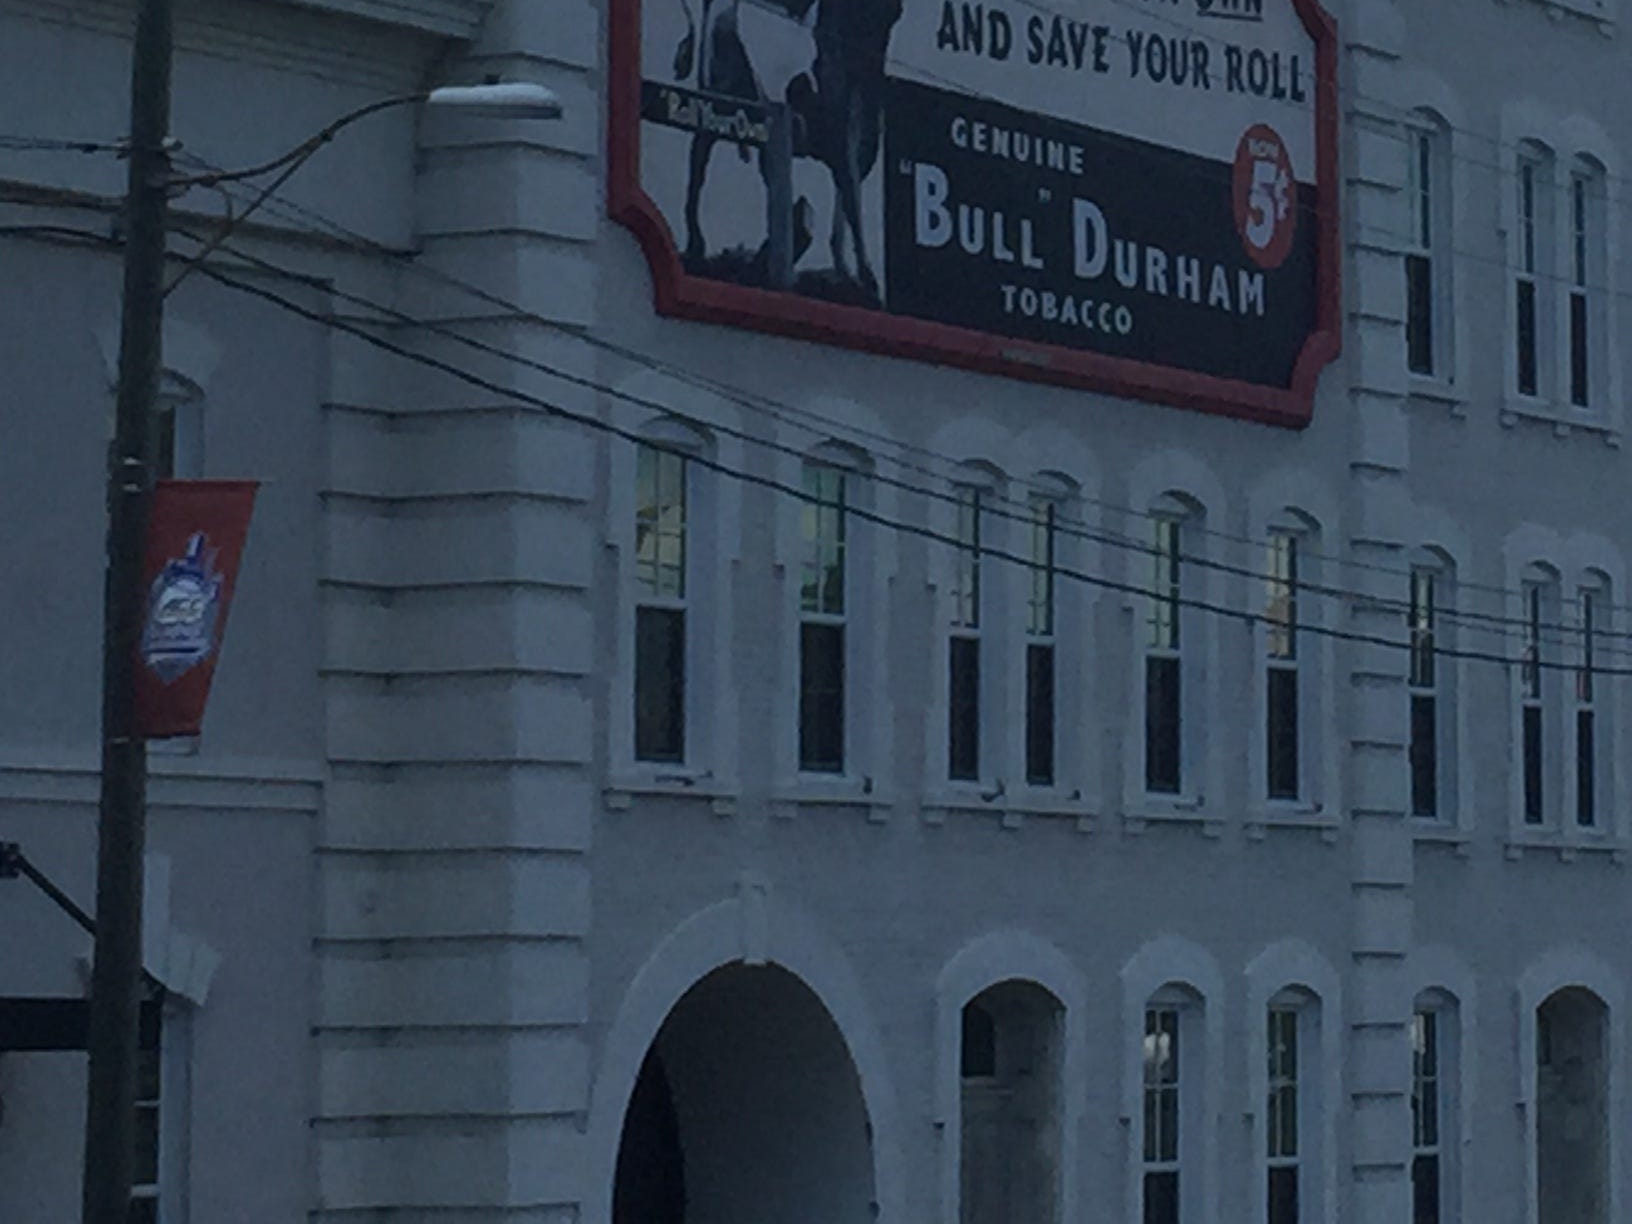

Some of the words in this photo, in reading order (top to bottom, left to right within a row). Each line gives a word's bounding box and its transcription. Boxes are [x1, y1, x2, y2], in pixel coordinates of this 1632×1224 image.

[937, 0, 1013, 62] AND
[1027, 15, 1111, 74] SAVE
[1126, 29, 1211, 90] YOUR
[1225, 45, 1306, 103] ROLL
[951, 117, 1085, 175] GENUINE
[1072, 197, 1265, 317] DURHAM
[1002, 284, 1134, 335] TOBACCO
